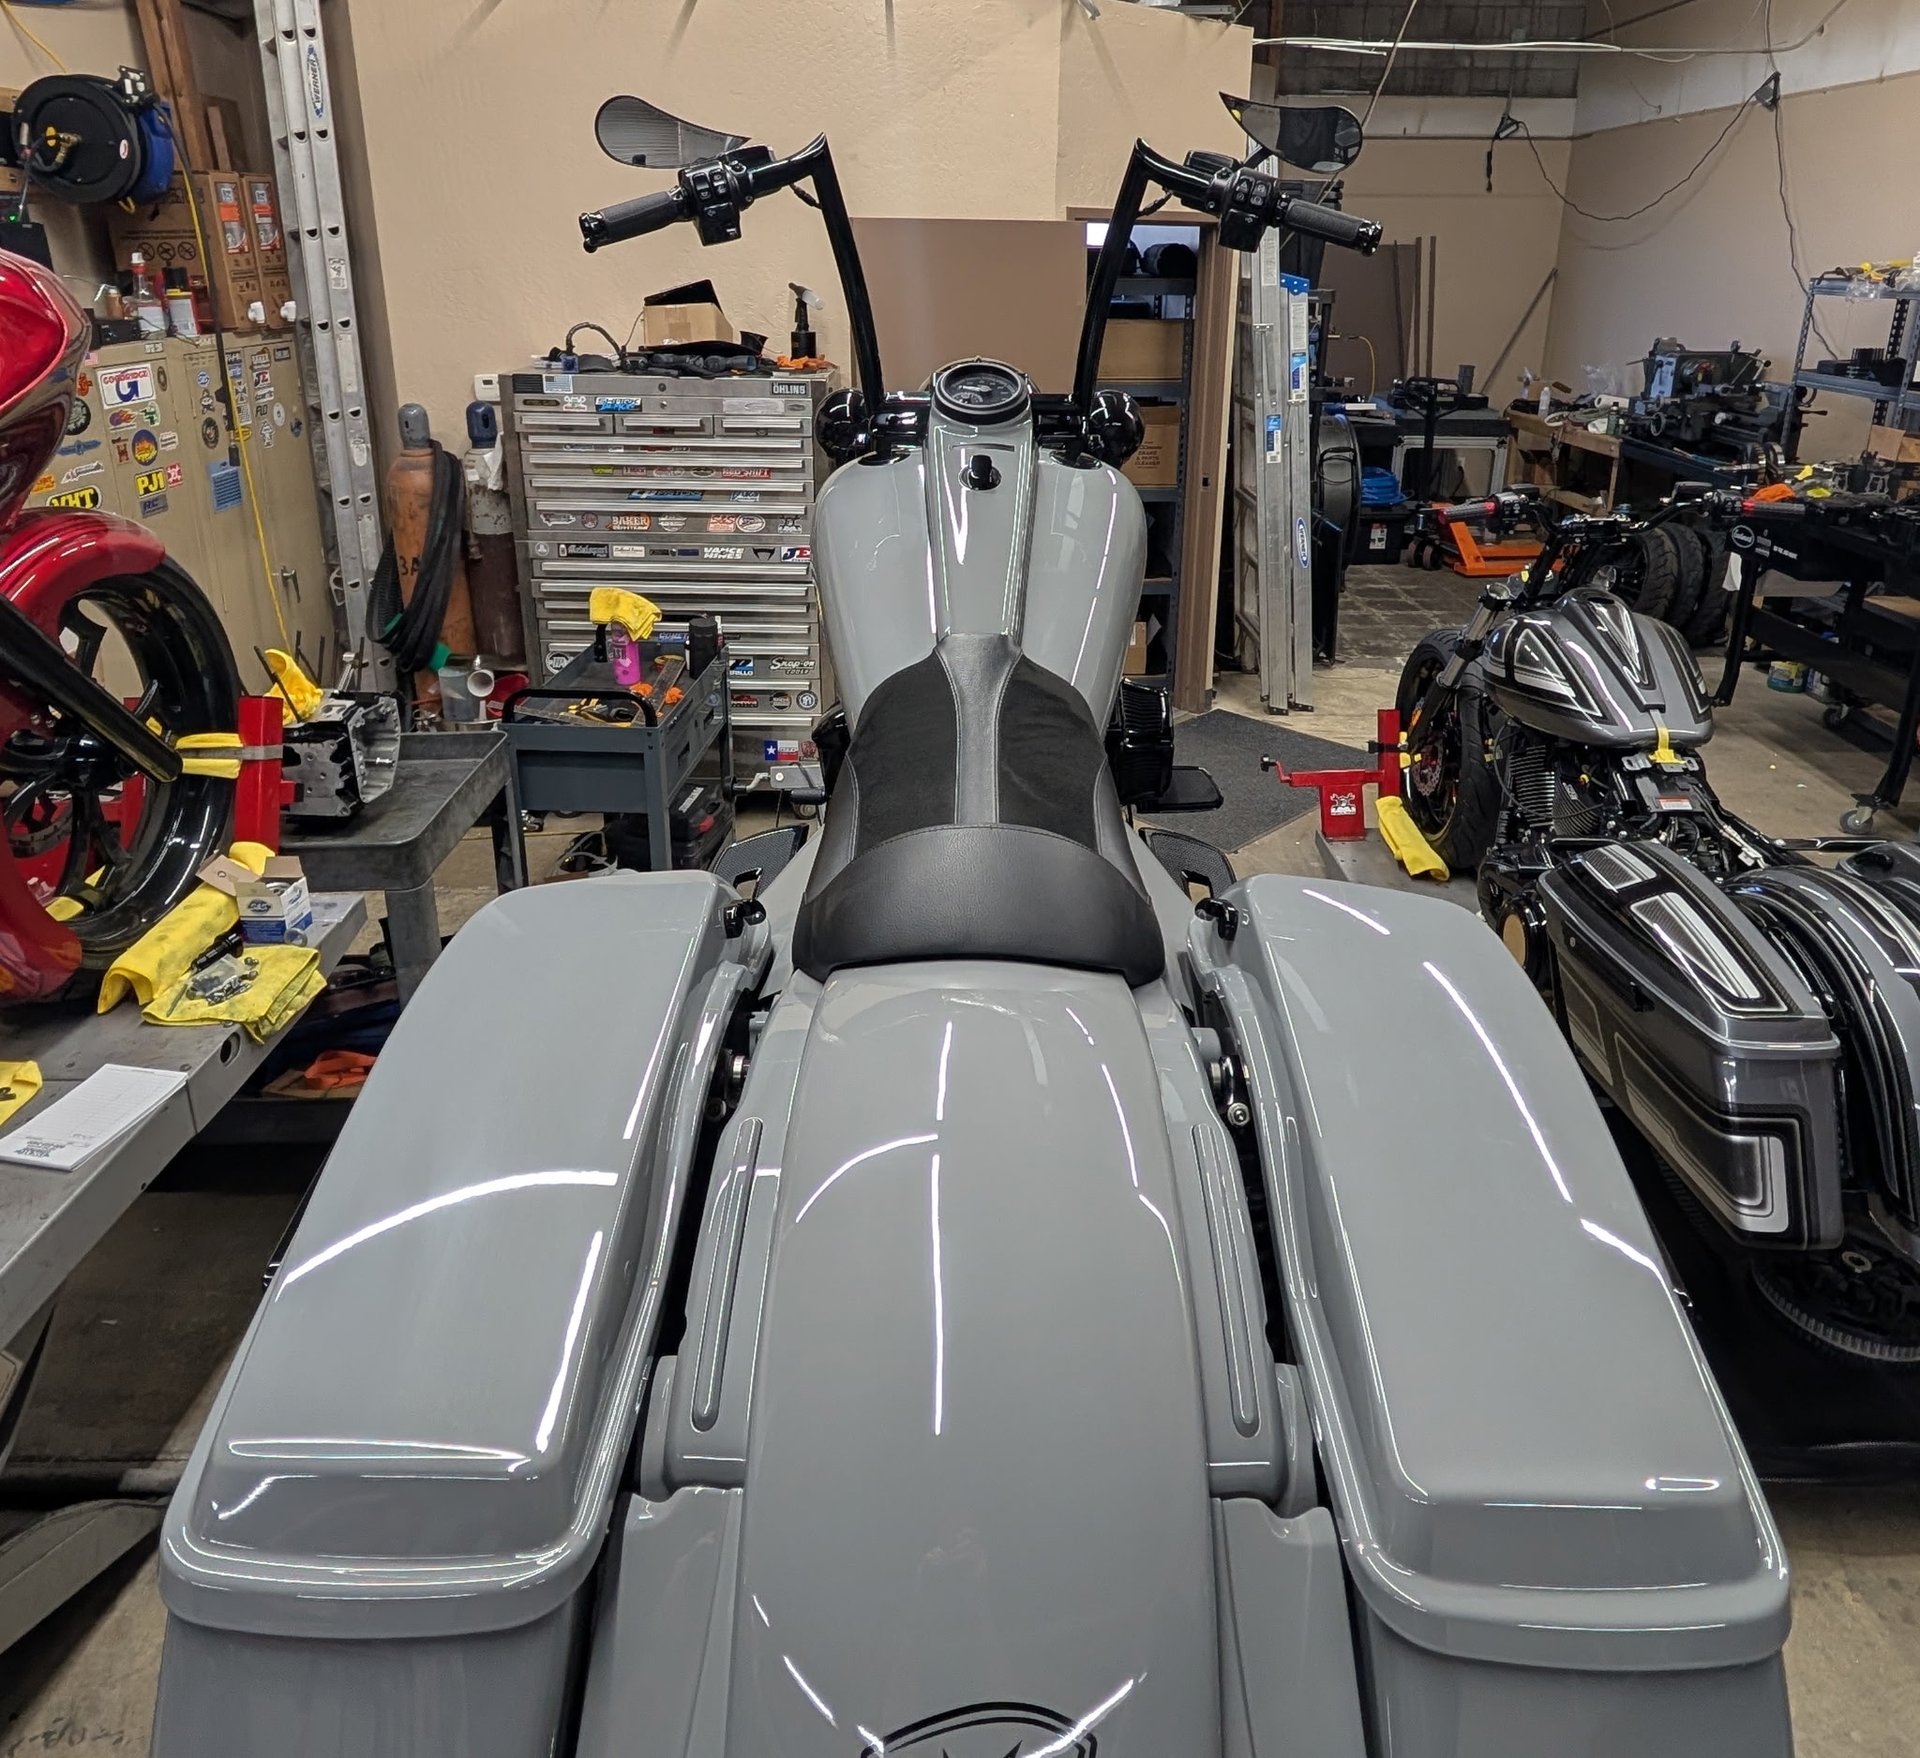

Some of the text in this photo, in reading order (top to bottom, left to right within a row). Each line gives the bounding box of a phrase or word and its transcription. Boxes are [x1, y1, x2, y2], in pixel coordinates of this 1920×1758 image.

[309, 59, 322, 103] WERNER
[103, 370, 149, 385] GOODRIDGE
[773, 380, 806, 394] ÖHLINS
[612, 516, 650, 525] BAKER
[770, 656, 815, 671] Snap-on
